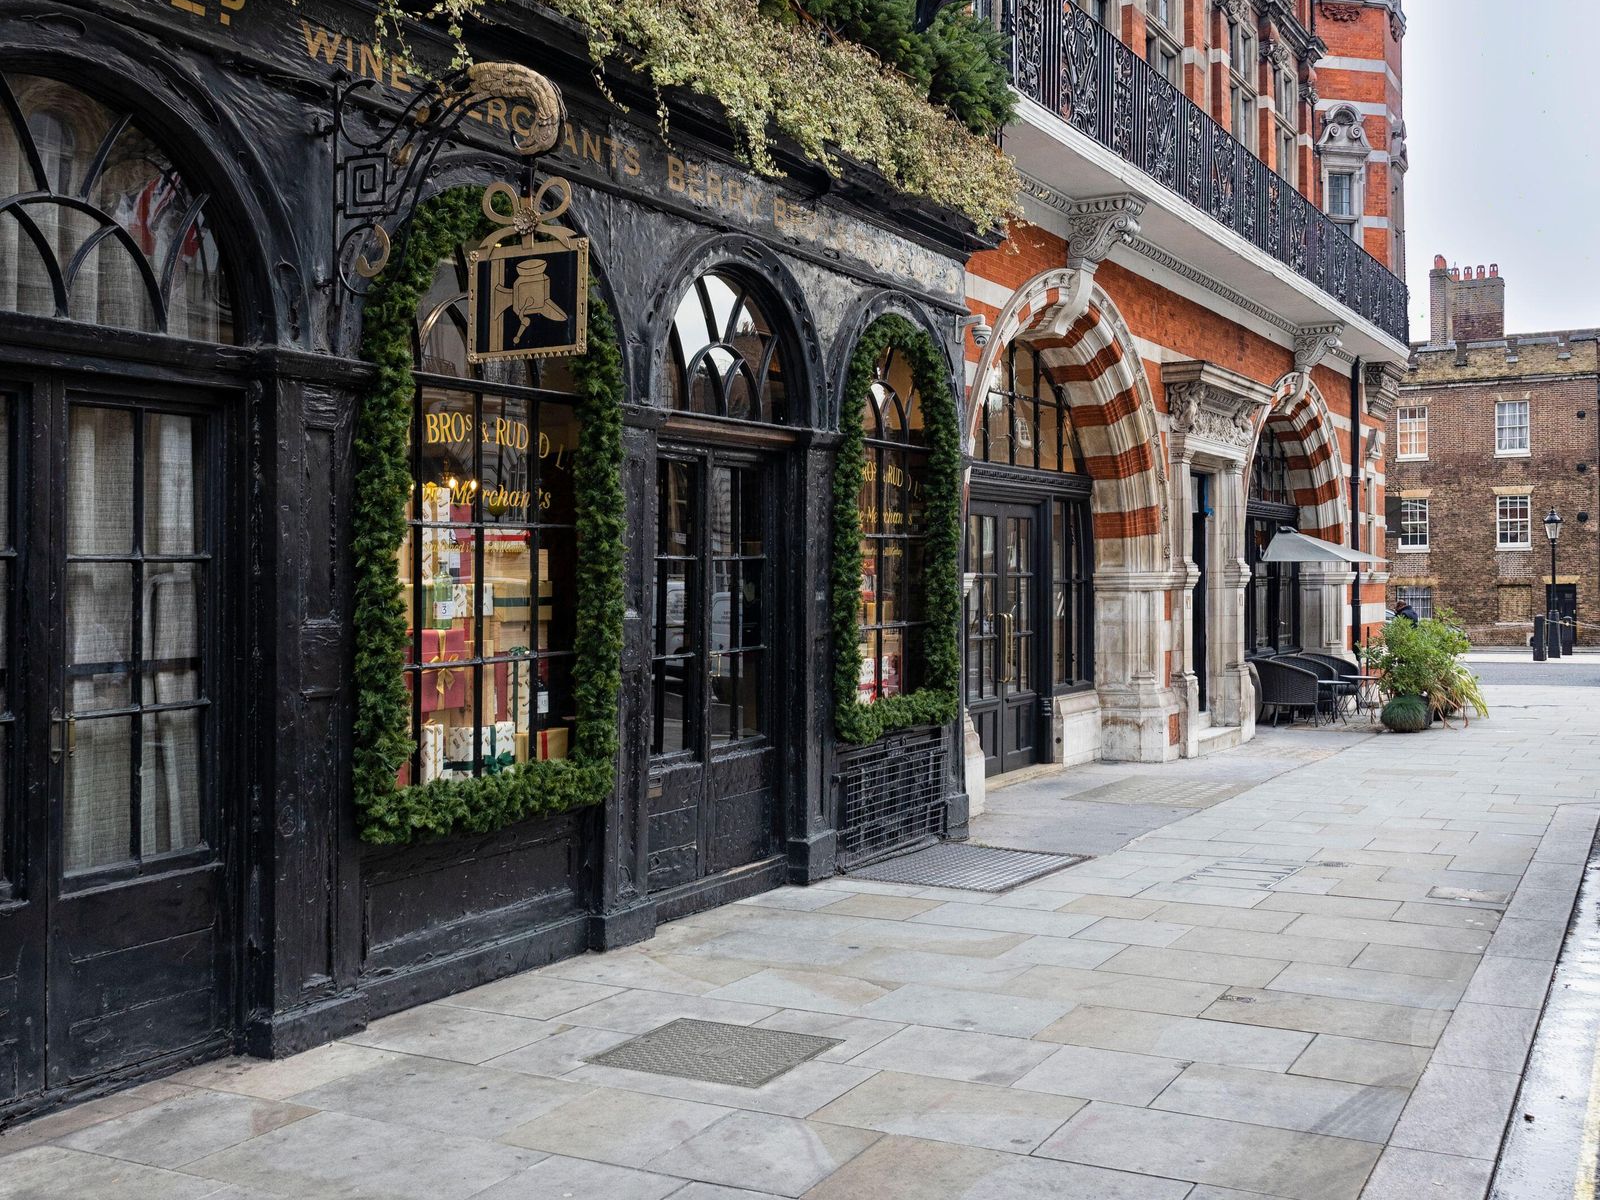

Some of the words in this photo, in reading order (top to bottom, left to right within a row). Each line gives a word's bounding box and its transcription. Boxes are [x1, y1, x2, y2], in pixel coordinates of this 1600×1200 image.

[300, 18, 413, 93] WINE
[481, 422, 490, 443] &
[495, 416, 550, 459] RUDD
